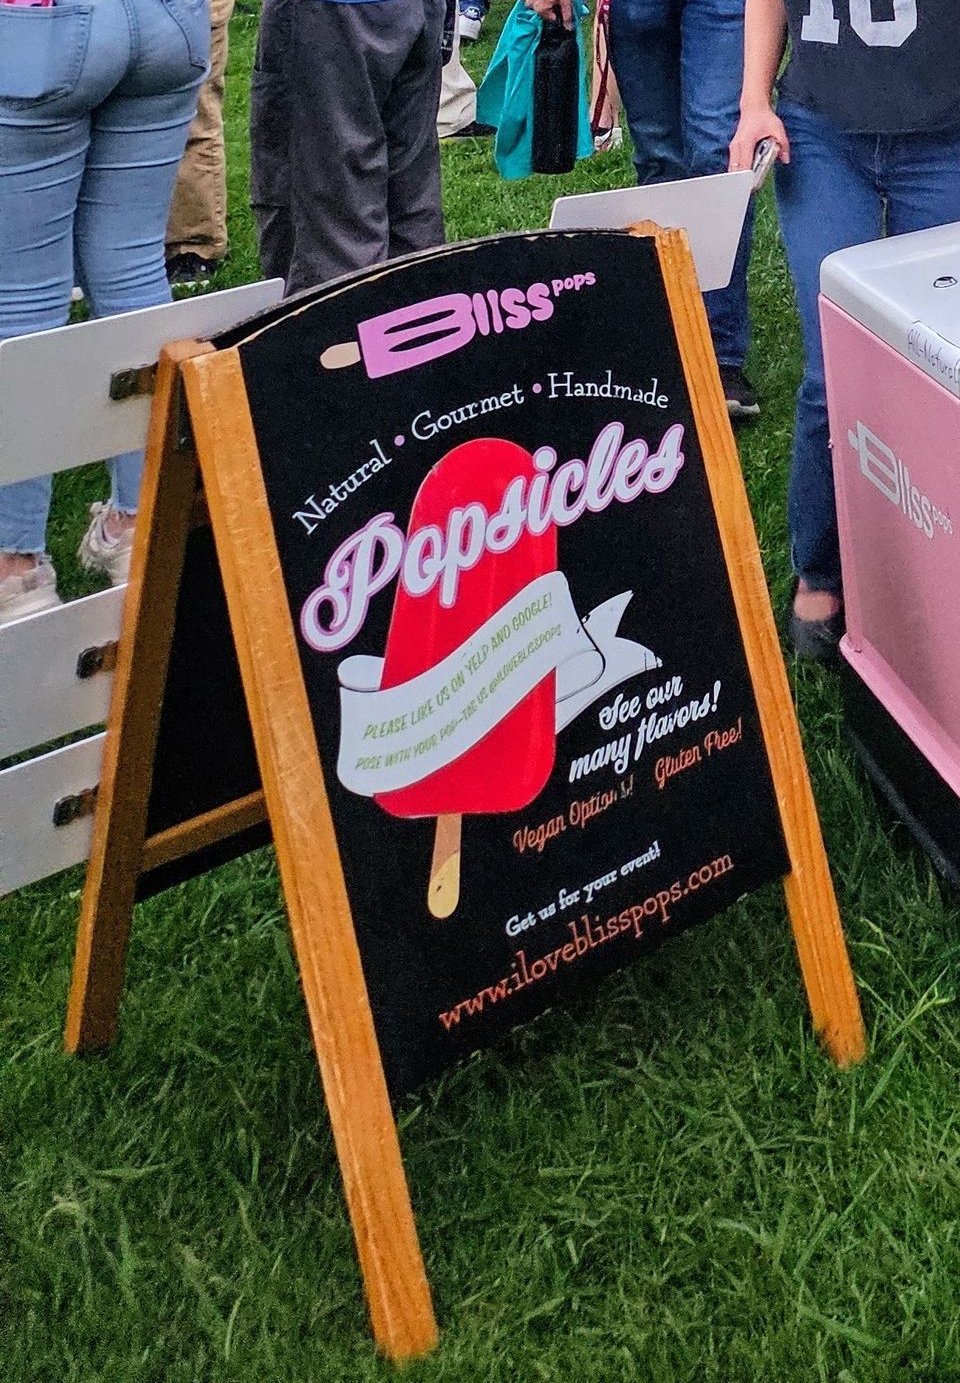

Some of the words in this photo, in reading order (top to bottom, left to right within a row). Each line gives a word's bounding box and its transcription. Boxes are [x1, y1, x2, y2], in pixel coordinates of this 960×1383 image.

[551, 271, 597, 297] pops
[292, 439, 393, 535] Natural
[411, 384, 525, 440] Gourmet
[548, 370, 669, 409] Handmade
[301, 421, 685, 652] Popsicles
[362, 713, 408, 739] PLEASE
[410, 698, 435, 726] LIKE
[436, 686, 450, 706] US
[450, 670, 465, 693] ON
[464, 644, 489, 675] YELP
[491, 625, 511, 652] AND
[512, 592, 553, 631] GOOGLE!
[599, 693, 642, 731] See
[646, 675, 684, 710] our
[355, 755, 382, 770] POSE
[385, 747, 411, 766] WITH
[413, 733, 438, 756] YOUR
[477, 687, 489, 704] US
[512, 814, 567, 853] Vegan
[654, 745, 702, 790] Gluten
[703, 717, 743, 756] Free!
[568, 732, 632, 783] many
[634, 679, 722, 761] flavors!
[438, 854, 735, 1031] www.iloveblisspops.com
[505, 912, 537, 937] Get
[538, 901, 557, 919] us
[558, 888, 581, 911] for
[582, 869, 618, 904] your
[620, 840, 661, 877] event!
